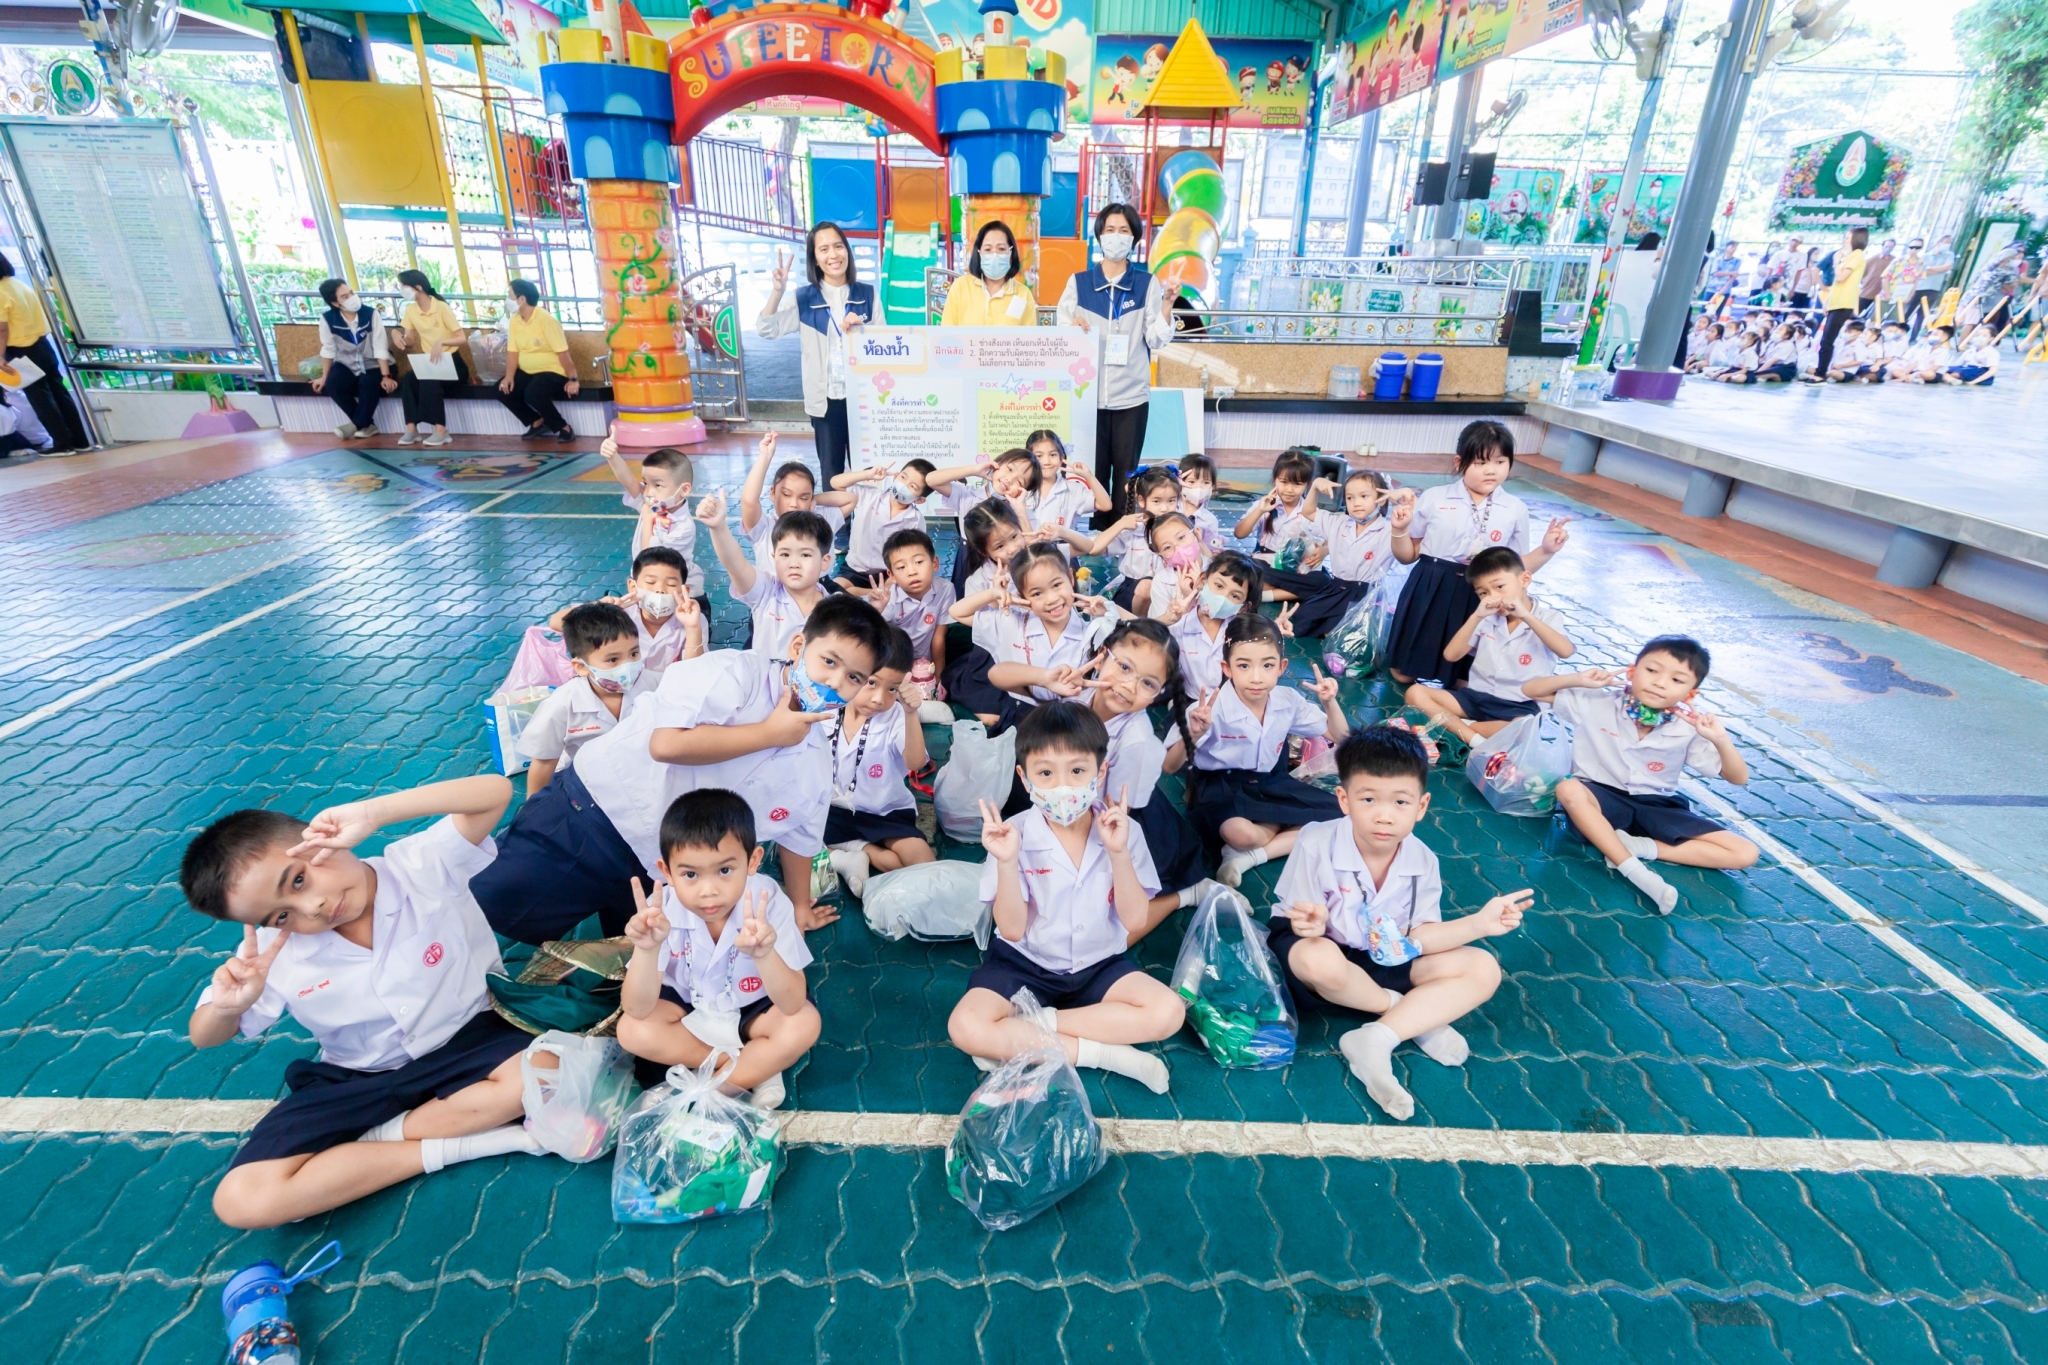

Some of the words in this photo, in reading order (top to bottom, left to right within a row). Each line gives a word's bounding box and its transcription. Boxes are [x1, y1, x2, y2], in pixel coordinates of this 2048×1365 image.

[1544, 5, 1579, 33] Volleyball
[767, 99, 800, 110] Running
[1262, 114, 1300, 124] Baseball
[863, 335, 909, 356] ห้องน้ำ
[979, 338, 1011, 347] ช่างสังเกต
[1013, 336, 1068, 349] เห็นอกเห็นใจผู้อื่น
[935, 346, 964, 355] ฝึกนิสัย
[979, 348, 1038, 357] ฝึกความรับผิดชอบ
[1040, 347, 1079, 357] ฝึกให้เป็นคน
[979, 358, 1014, 366] ไม่เลือกงาน
[1016, 358, 1045, 366] ไม่มักง่าย
[891, 396, 925, 406] สิ่งที่ควรทำ
[1000, 401, 1041, 411] สิ่งที่ไม่ควรทำ
